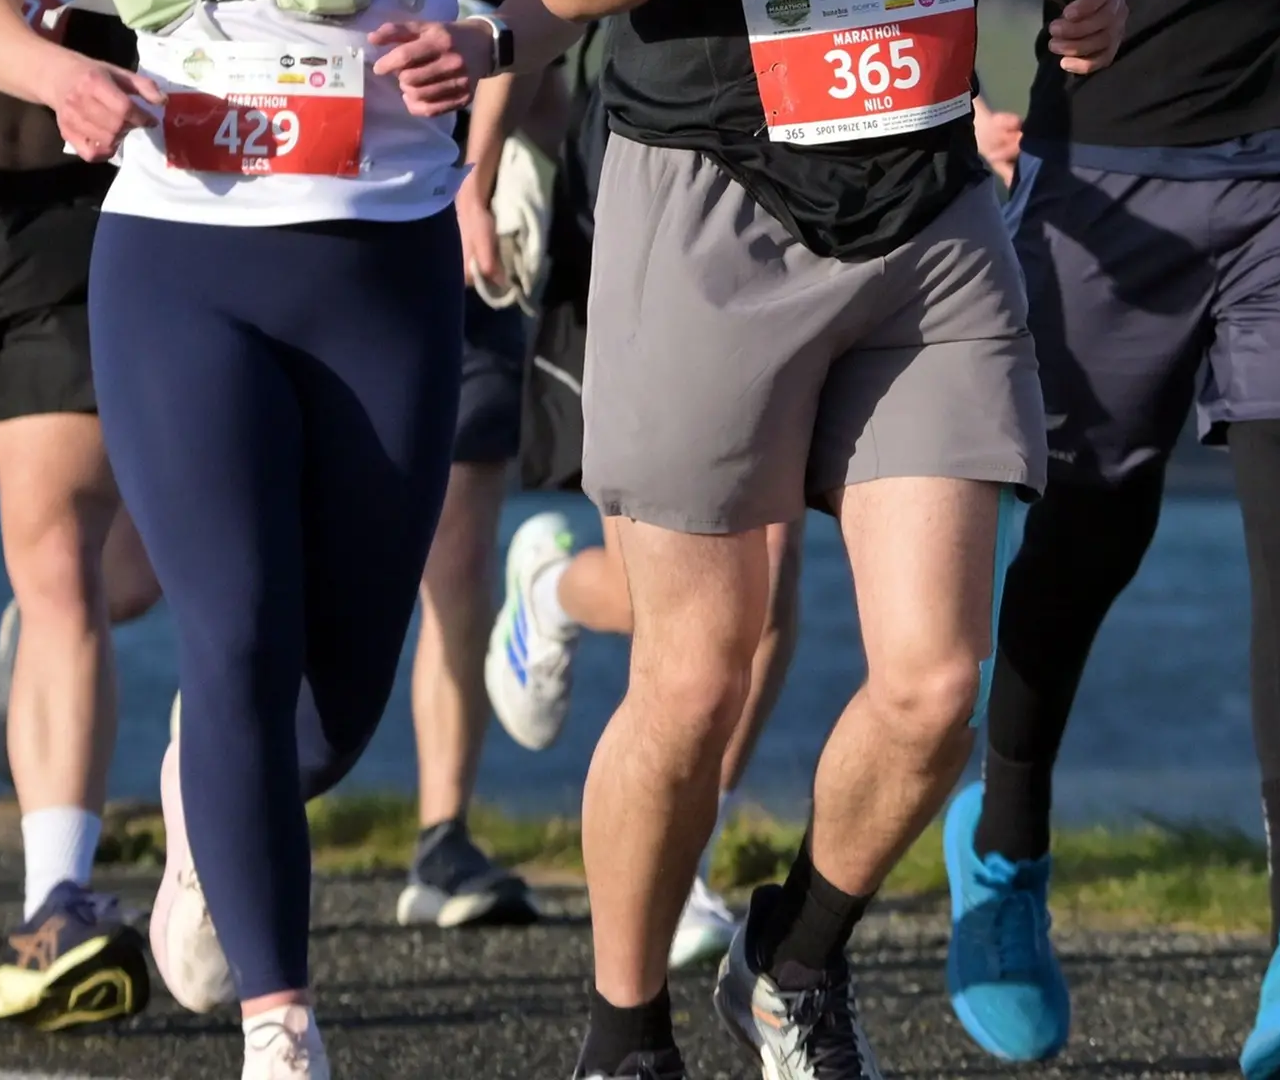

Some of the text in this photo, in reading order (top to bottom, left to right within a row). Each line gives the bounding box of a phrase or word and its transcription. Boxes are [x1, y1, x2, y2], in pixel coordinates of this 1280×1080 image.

[833, 24, 901, 46] MARATHON
[823, 38, 921, 100] 365
[227, 95, 287, 109] MARATHON
[864, 96, 893, 112] NILO
[213, 110, 300, 156] 429
[785, 120, 878, 140] 365 SPOT PRIZE TAG
